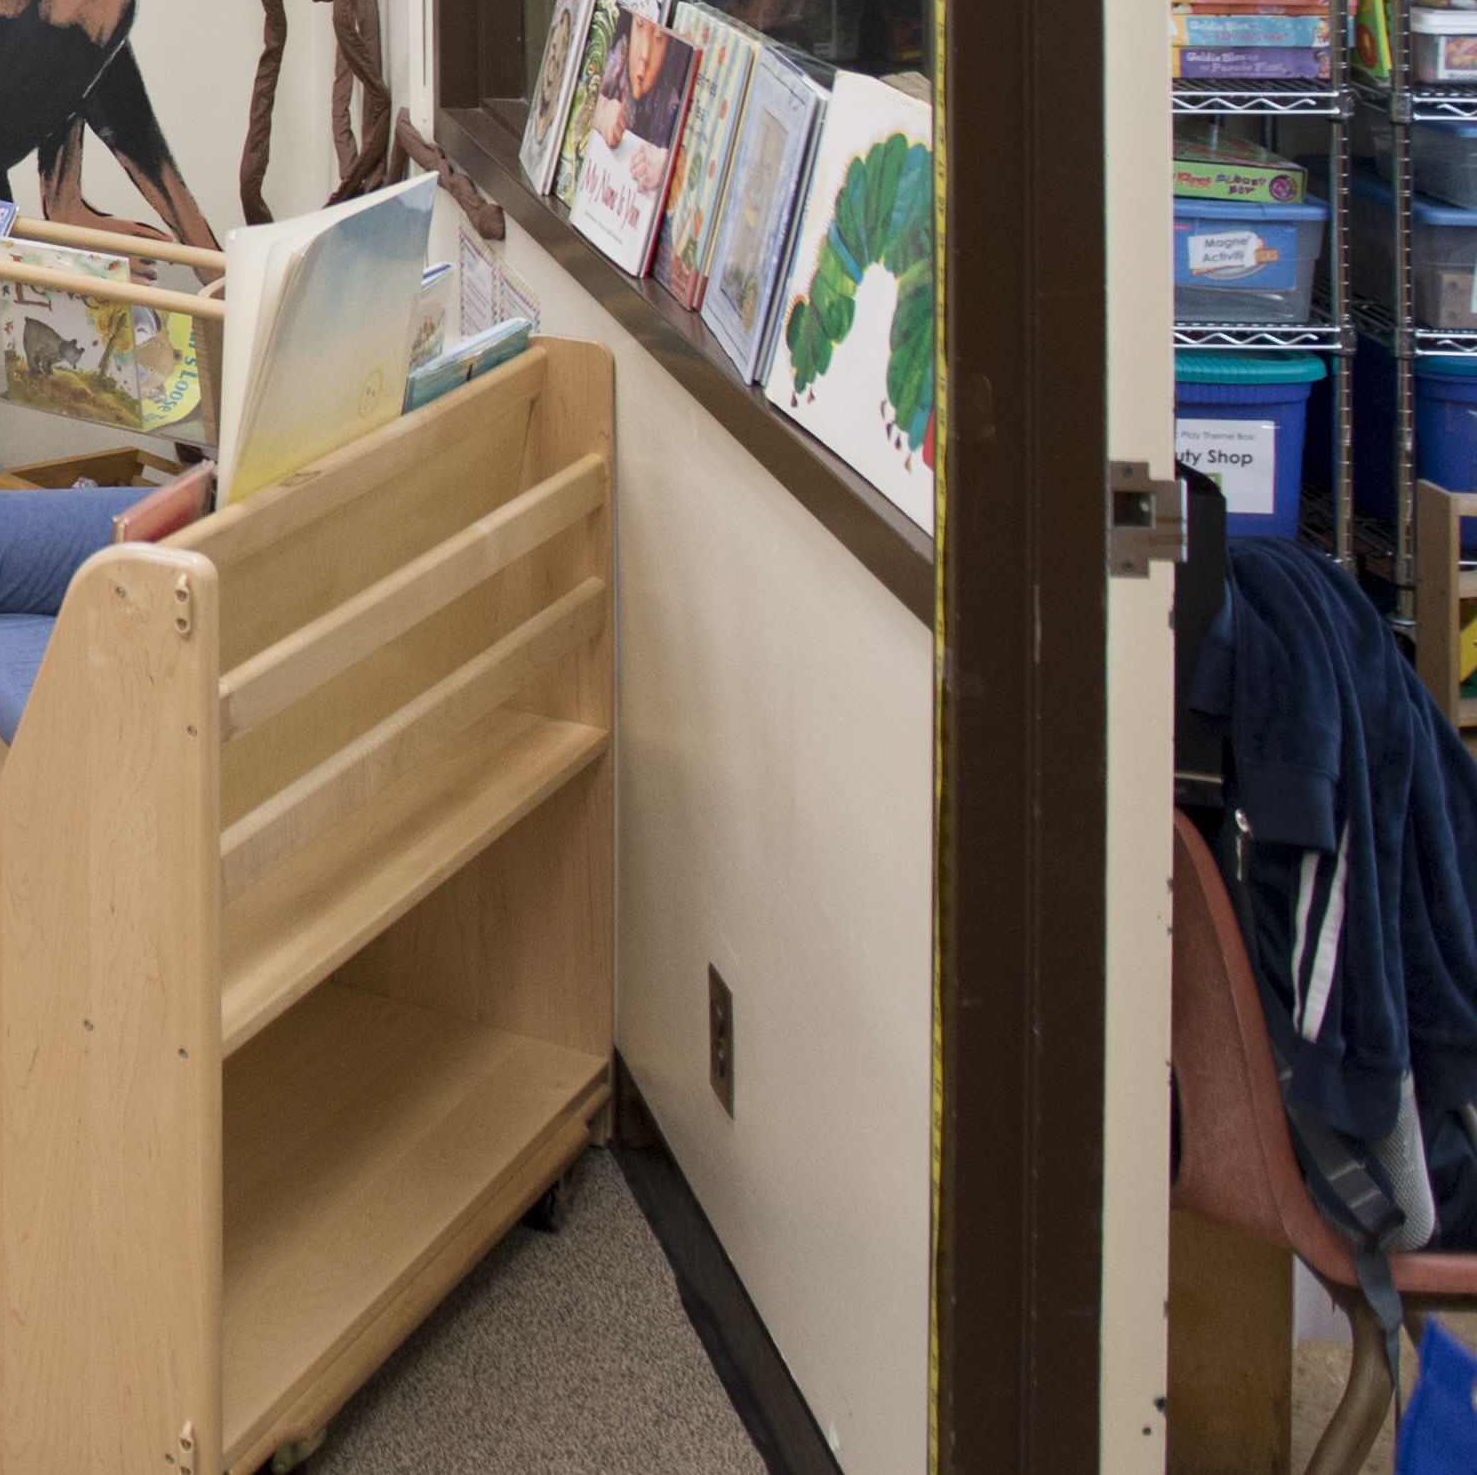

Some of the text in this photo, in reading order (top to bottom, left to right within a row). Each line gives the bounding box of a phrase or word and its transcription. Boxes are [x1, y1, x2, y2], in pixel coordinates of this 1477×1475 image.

[1204, 235, 1251, 249] Magne
[1202, 250, 1245, 263] Activiti
[158, 370, 197, 413] Loose
[1181, 430, 1200, 440] Play
[1203, 431, 1234, 440] Theme
[1175, 449, 1253, 467] uty Shop
